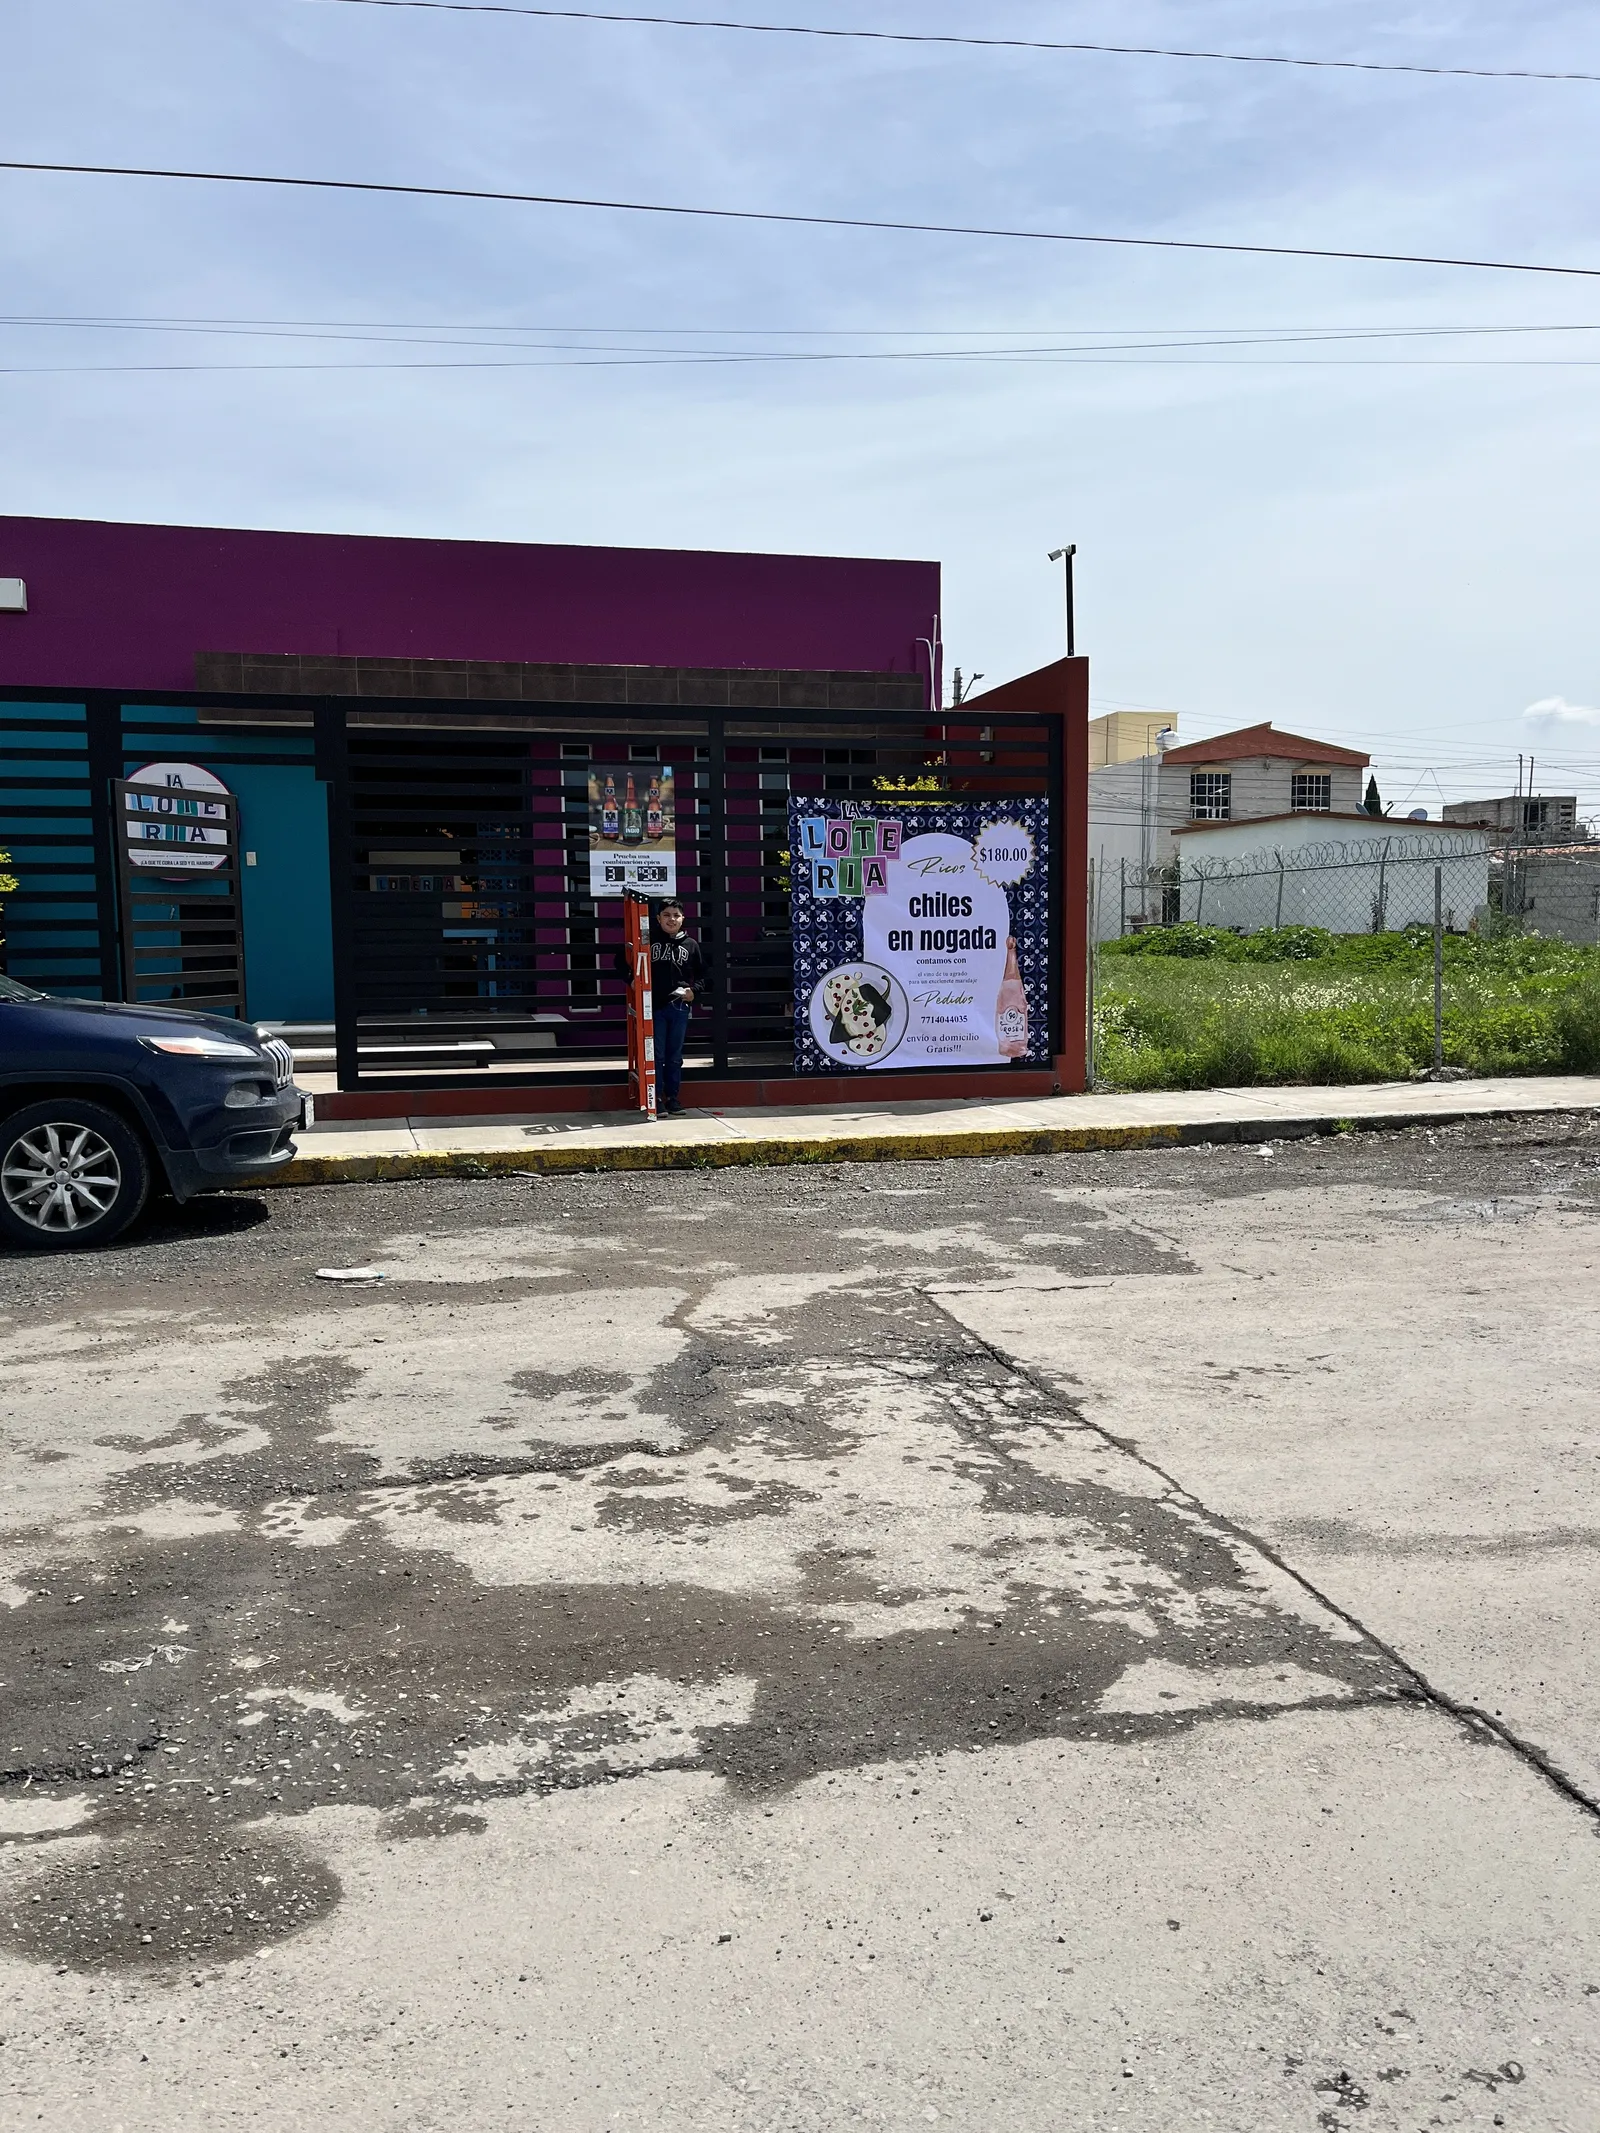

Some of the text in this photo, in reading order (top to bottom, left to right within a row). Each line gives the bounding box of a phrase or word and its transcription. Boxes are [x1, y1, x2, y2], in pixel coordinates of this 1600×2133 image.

[841, 800, 862, 821] LA
[808, 825, 898, 852] LOTE
[980, 847, 1027, 863] $180.00
[817, 863, 885, 889] RIA
[908, 856, 965, 877] Ricos
[909, 892, 972, 917] chiles
[888, 926, 996, 953] en nogada
[651, 942, 689, 966] GAP
[913, 990, 973, 1007] Pedidos
[921, 1015, 968, 1024] 7714044035
[907, 1034, 929, 1042] envío
[939, 1032, 979, 1041] domicilio
[926, 1045, 962, 1053] Gratis!!!
